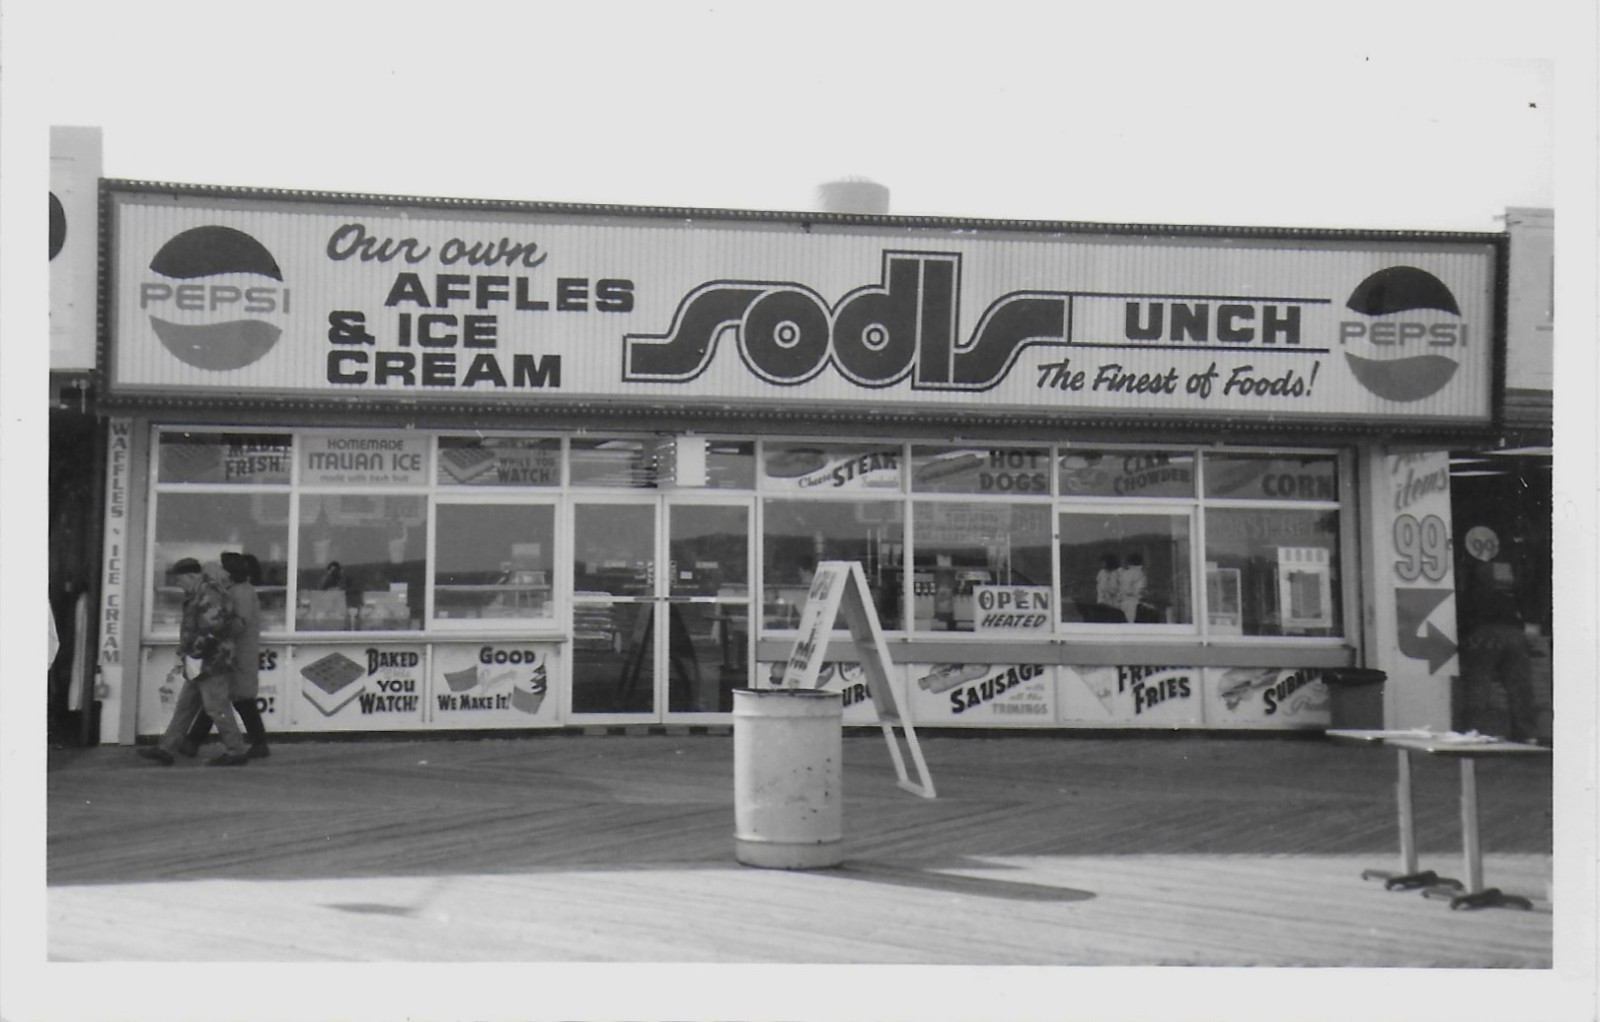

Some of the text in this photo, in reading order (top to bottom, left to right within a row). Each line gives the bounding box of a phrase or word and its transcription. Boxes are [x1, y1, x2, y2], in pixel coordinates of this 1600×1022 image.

[326, 223, 548, 268] Our own
[140, 282, 290, 314] PEPSI
[384, 272, 635, 313] AFFLES
[327, 311, 498, 349] & ICE
[1126, 303, 1300, 344] UNCH
[1339, 321, 1468, 347] PEPSI
[326, 351, 561, 388] CREAM
[1037, 358, 1320, 399] The Finest of Foods!
[328, 439, 403, 450] HOMEMADE
[990, 450, 1041, 469] HOT
[308, 452, 421, 471] ITALIAN ICE
[833, 451, 898, 487] STEAK
[979, 472, 1046, 491] DOGS
[1113, 468, 1190, 495] CHOWDER
[1262, 474, 1333, 497] CORN
[104, 424, 128, 663] WAFFLES ICE CREAM
[978, 590, 1049, 611] OPEN
[981, 614, 1047, 628] HEATED
[377, 680, 415, 693] YOU
[951, 664, 1044, 714] SAUSAGE
[1133, 677, 1191, 714] FRIES
